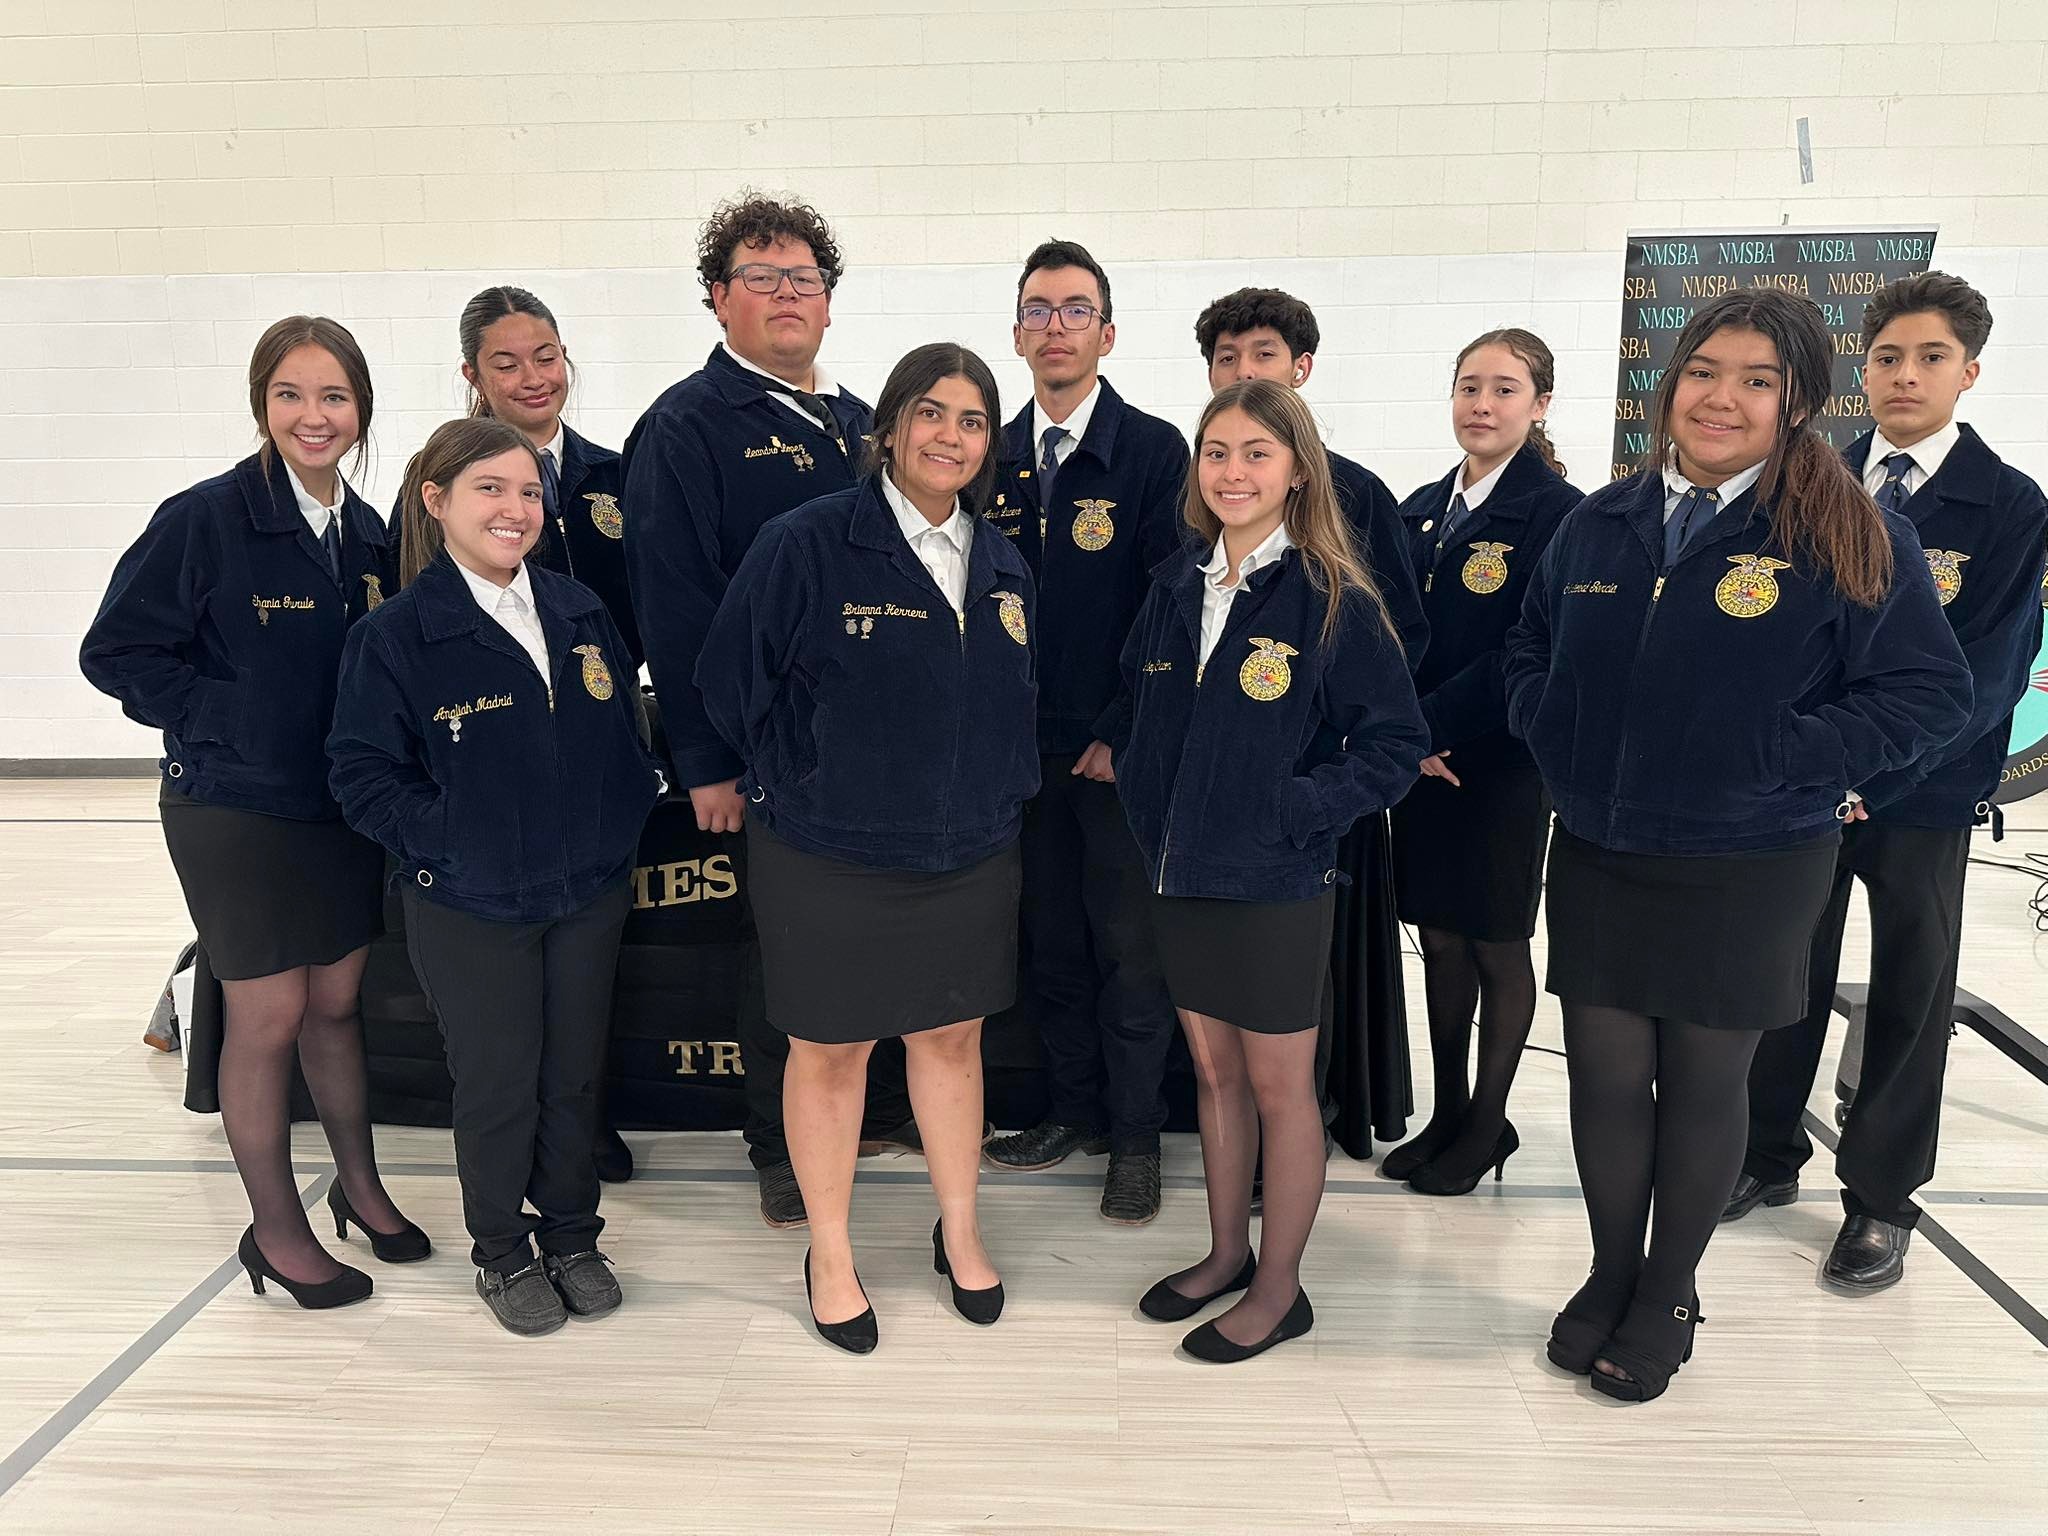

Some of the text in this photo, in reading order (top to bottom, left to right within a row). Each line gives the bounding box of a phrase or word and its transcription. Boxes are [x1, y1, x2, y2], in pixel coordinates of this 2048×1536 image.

[1640, 238, 1932, 266] NMSBA NMSBA NMSBA NMSBA
[1681, 275, 1738, 298] NMSBA
[1827, 272, 1886, 296] NMSBA
[842, 602, 928, 619] Brianna Herrera
[475, 691, 514, 712] Madrid
[2000, 752, 2048, 782] OARDS
[668, 1040, 745, 1076] TR
